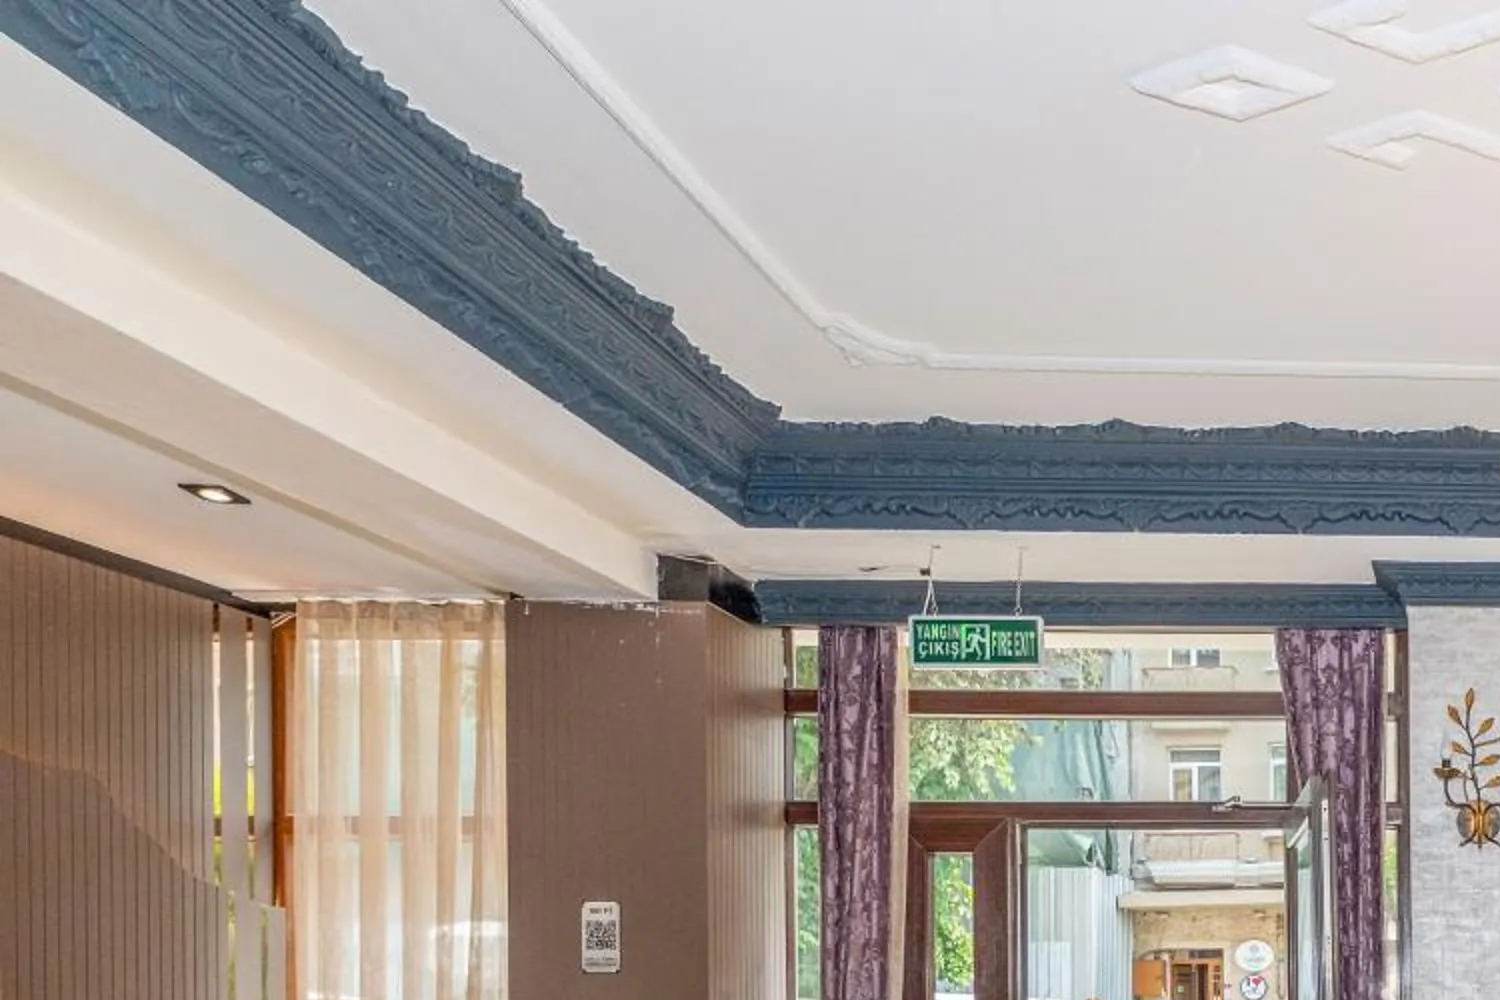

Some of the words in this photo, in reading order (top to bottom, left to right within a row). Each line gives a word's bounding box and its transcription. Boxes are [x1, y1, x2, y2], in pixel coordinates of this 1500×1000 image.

[915, 623, 959, 641] YANGIN
[918, 641, 960, 660] ÇIKIŞ
[992, 631, 1012, 657] FIRE
[1014, 631, 1035, 657] EXIT
